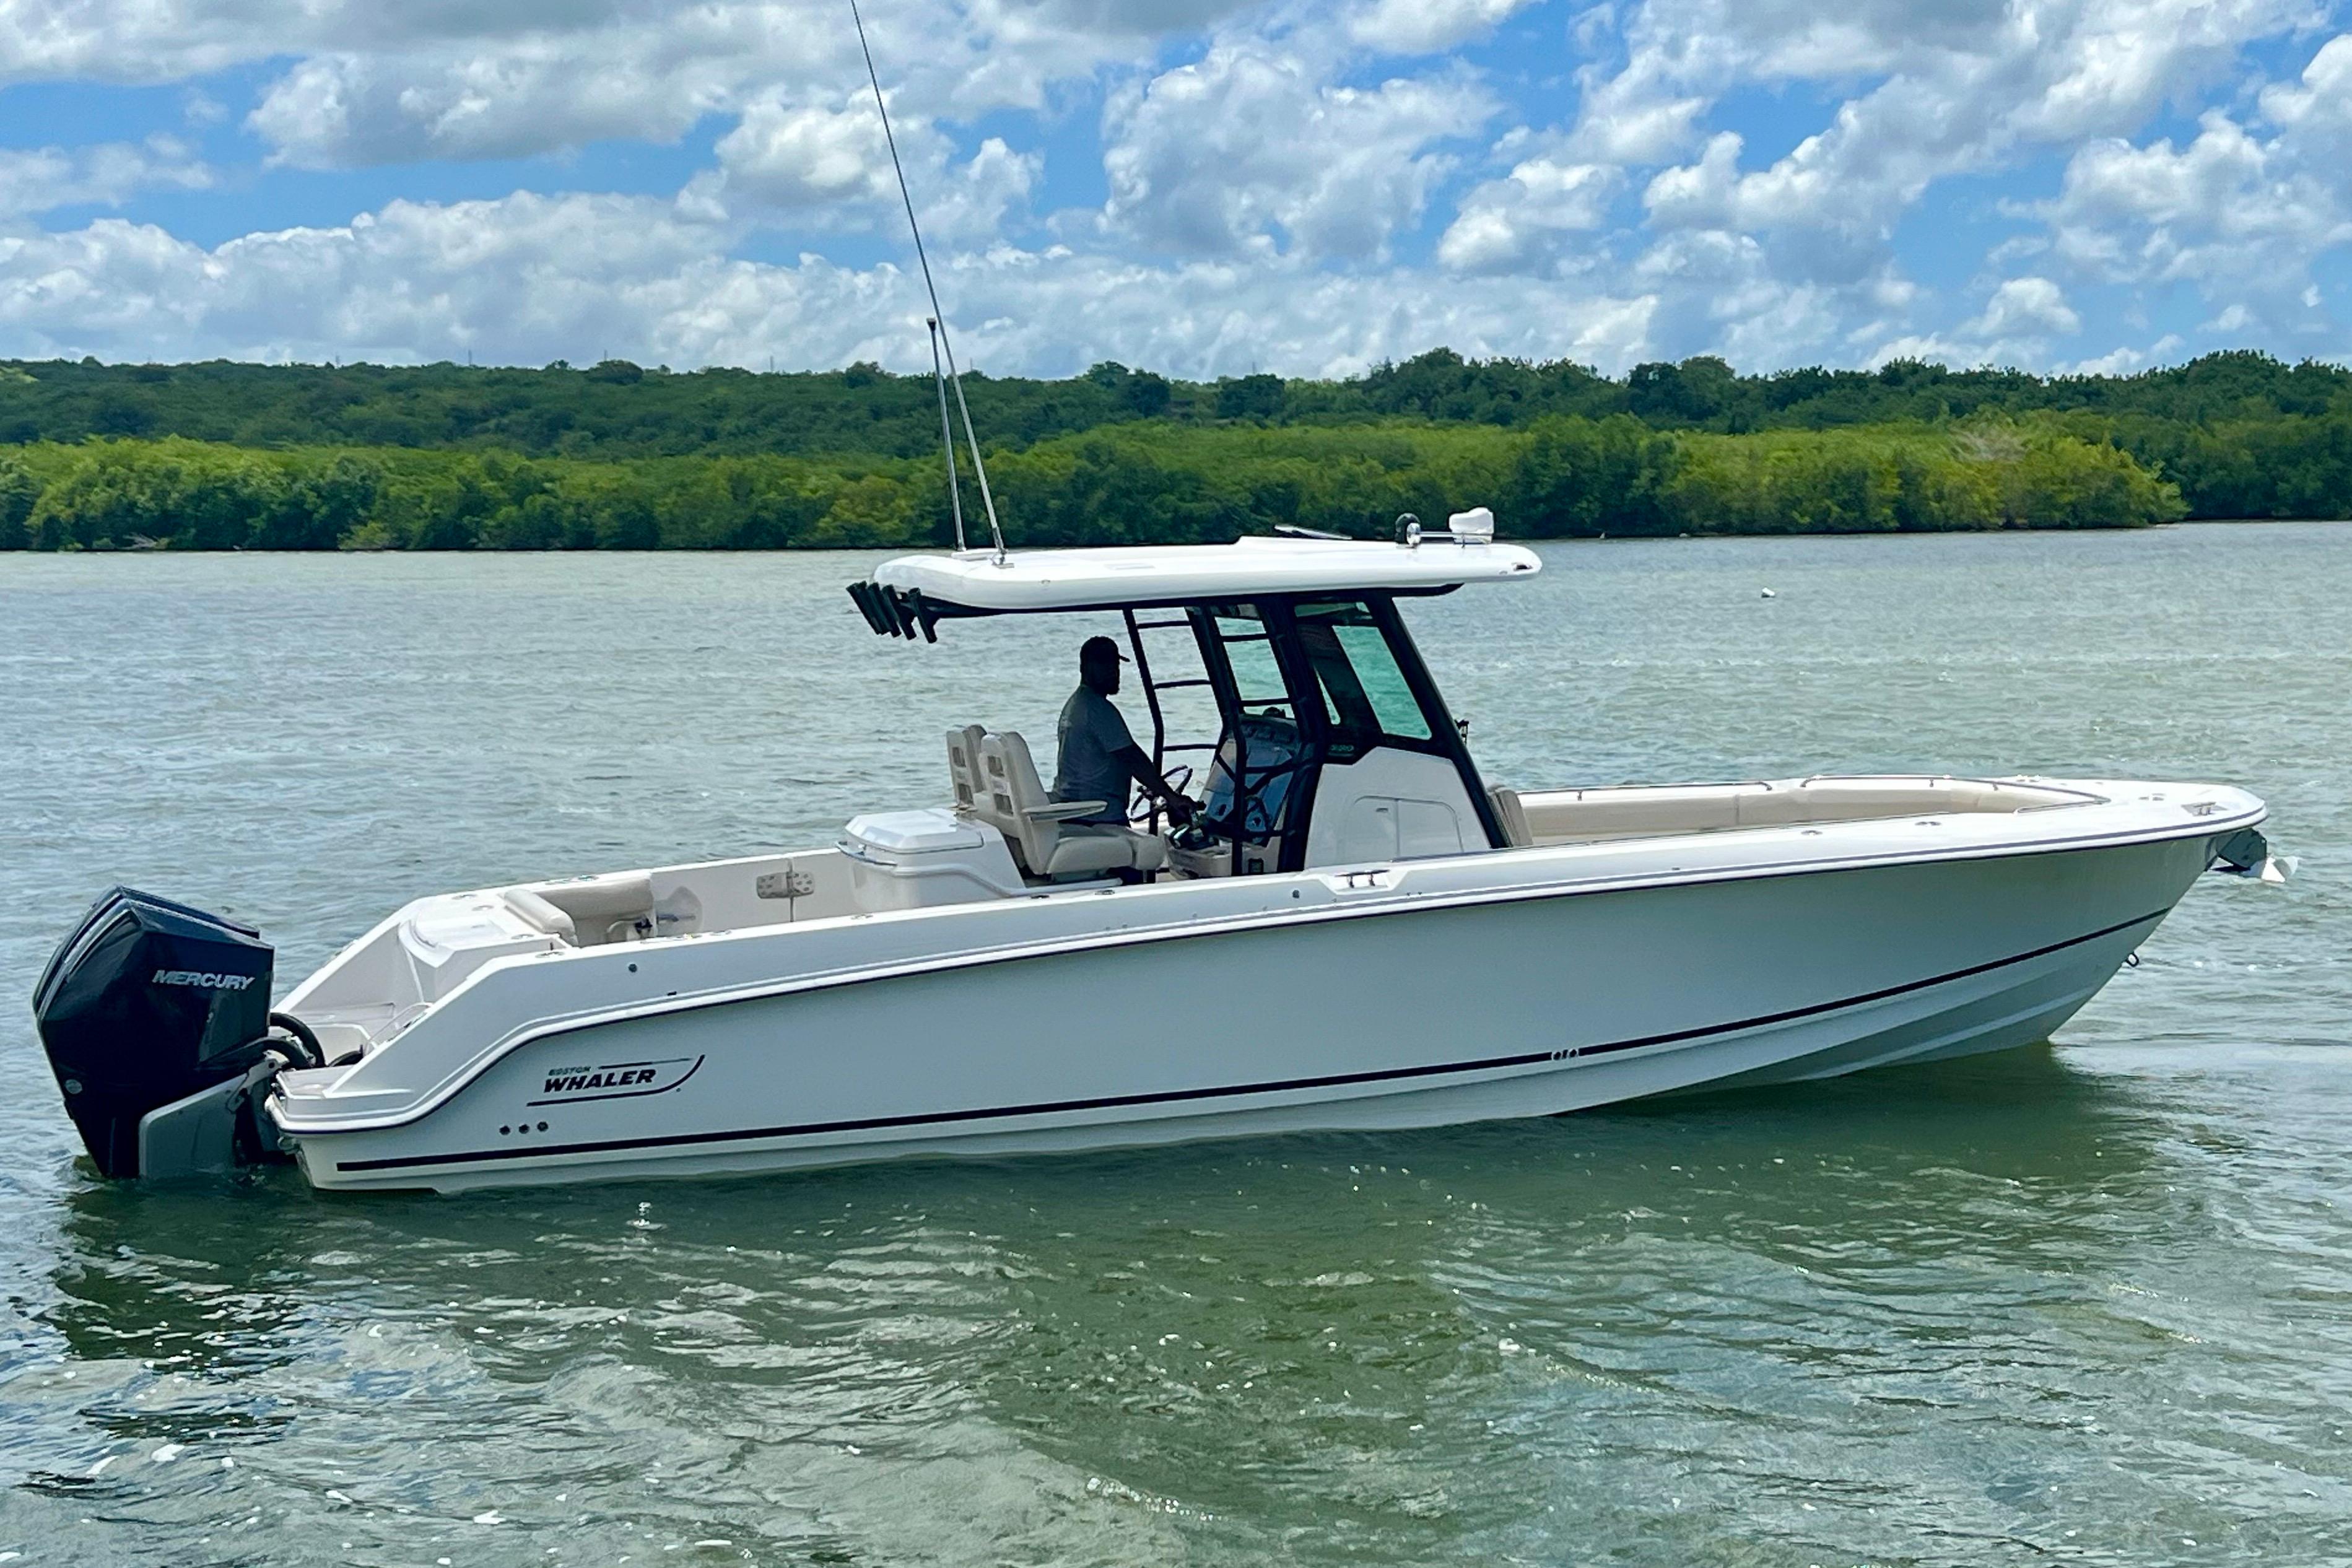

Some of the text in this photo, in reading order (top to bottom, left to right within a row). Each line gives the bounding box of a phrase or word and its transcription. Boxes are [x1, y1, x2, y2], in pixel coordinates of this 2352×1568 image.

[152, 970, 255, 990] MERCURY
[544, 1069, 656, 1093] WHALER
[548, 1066, 591, 1076] BOSTON
